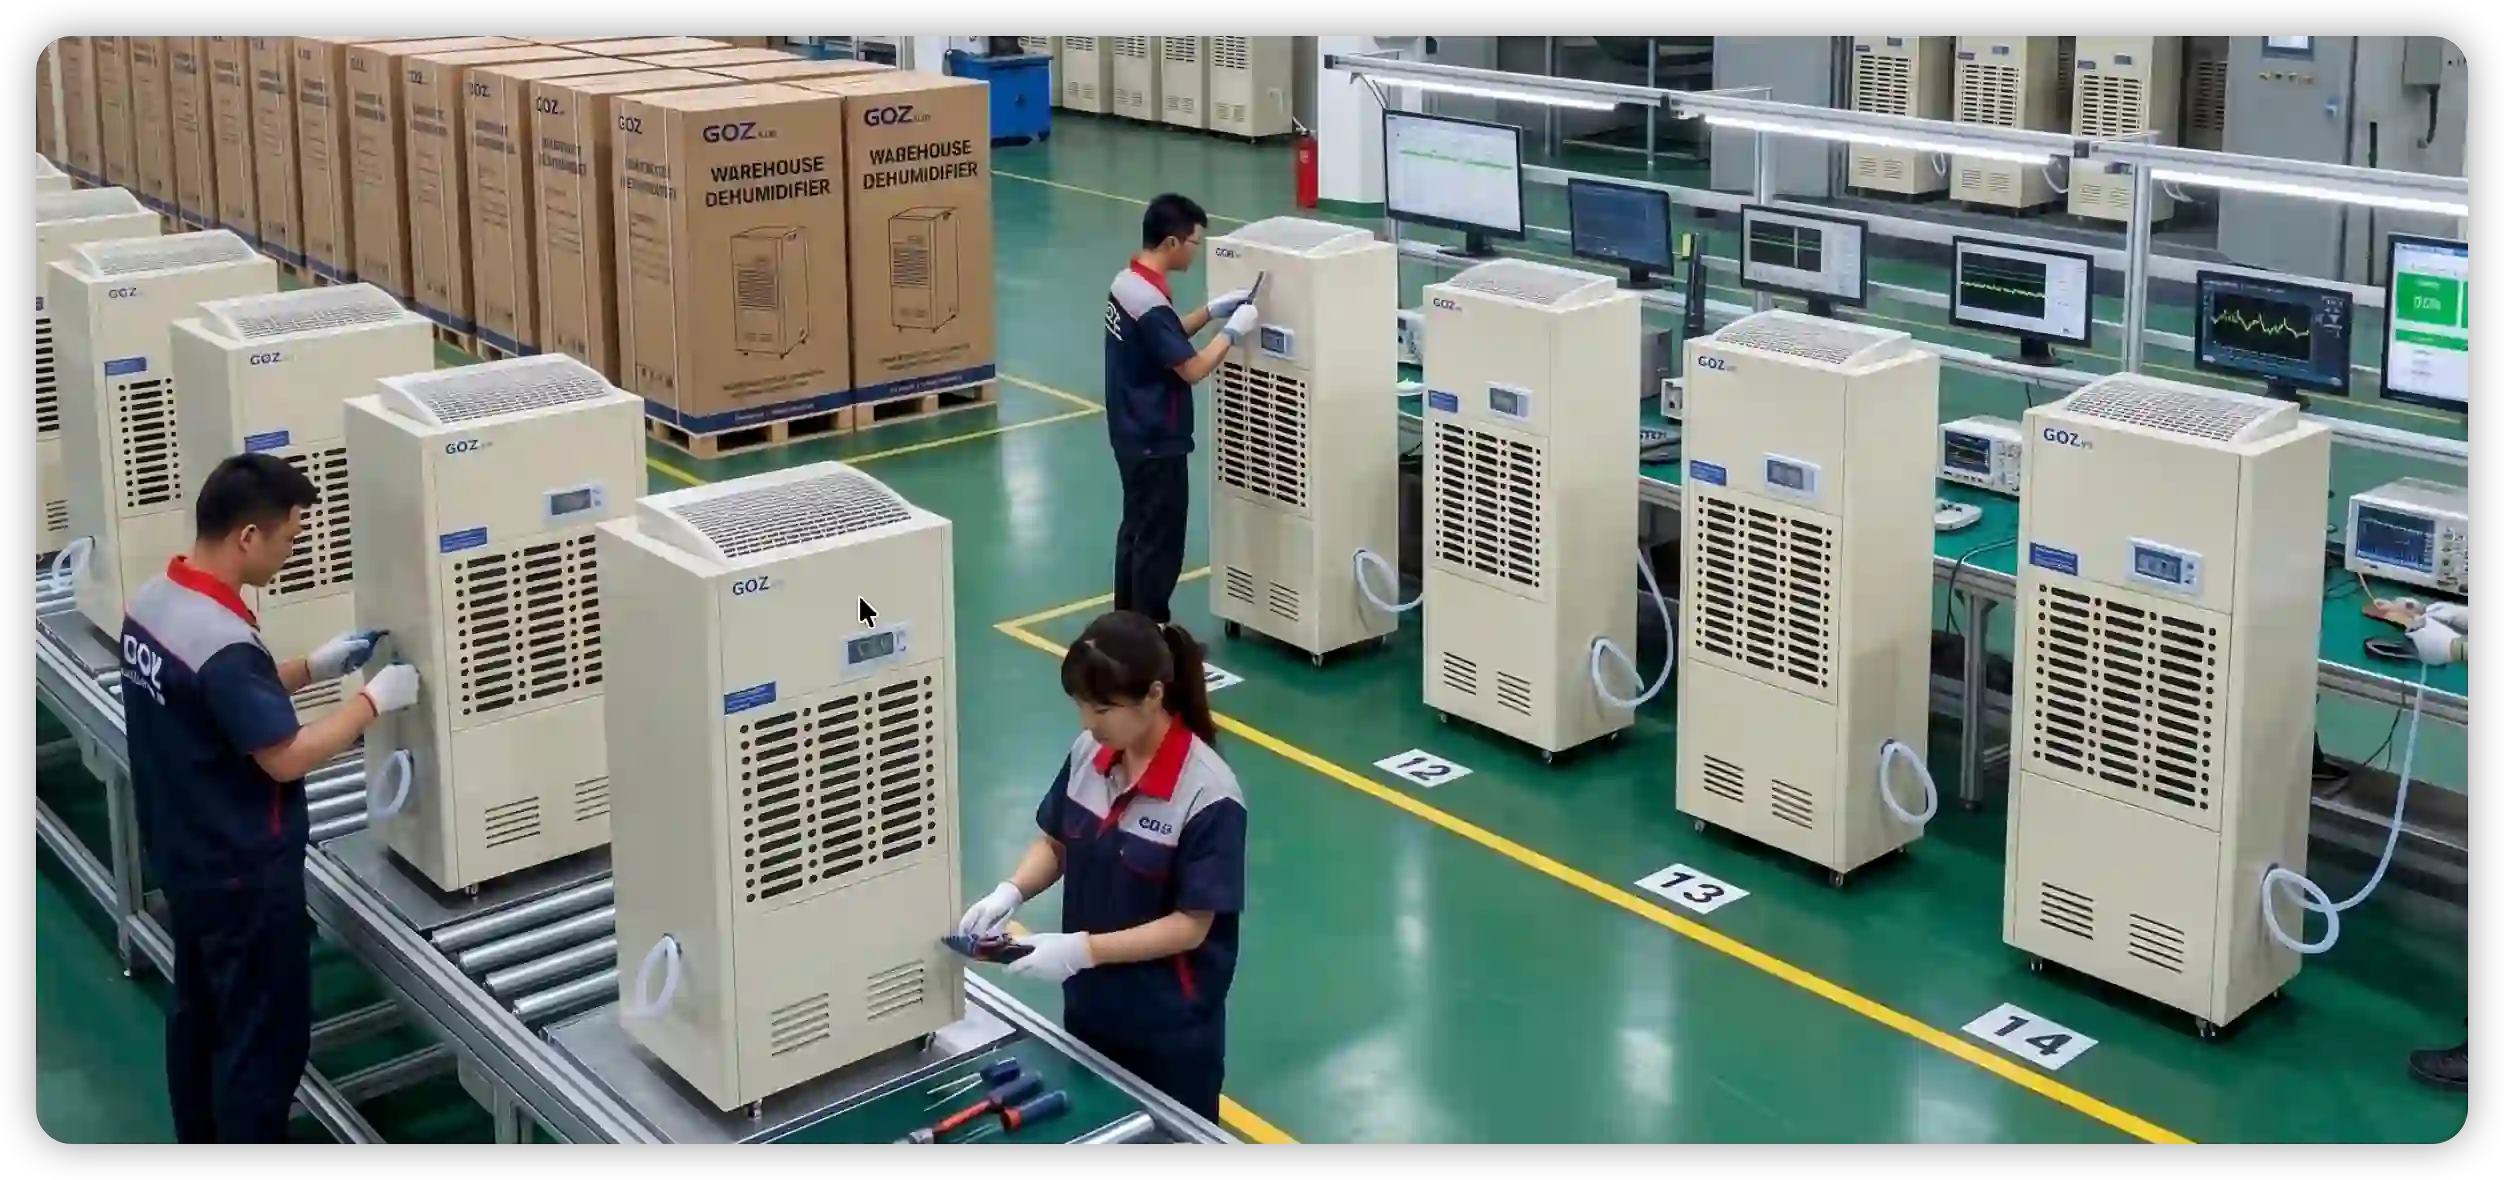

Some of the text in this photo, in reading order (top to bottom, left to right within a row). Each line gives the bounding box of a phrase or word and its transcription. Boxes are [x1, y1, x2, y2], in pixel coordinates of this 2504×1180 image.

[863, 105, 914, 128] GOZ
[702, 122, 757, 143] GOZ
[710, 155, 826, 184] WAREHOUSE
[862, 161, 979, 191] DEHUMIDIFIER
[705, 178, 831, 208] DEHUMIDIFIER
[445, 439, 479, 456] GOZ
[2043, 427, 2081, 448] GOZ
[732, 575, 770, 596] GOZ
[1397, 756, 1452, 781] 12
[1659, 871, 1726, 904] 13
[1993, 1015, 2074, 1056] 14
